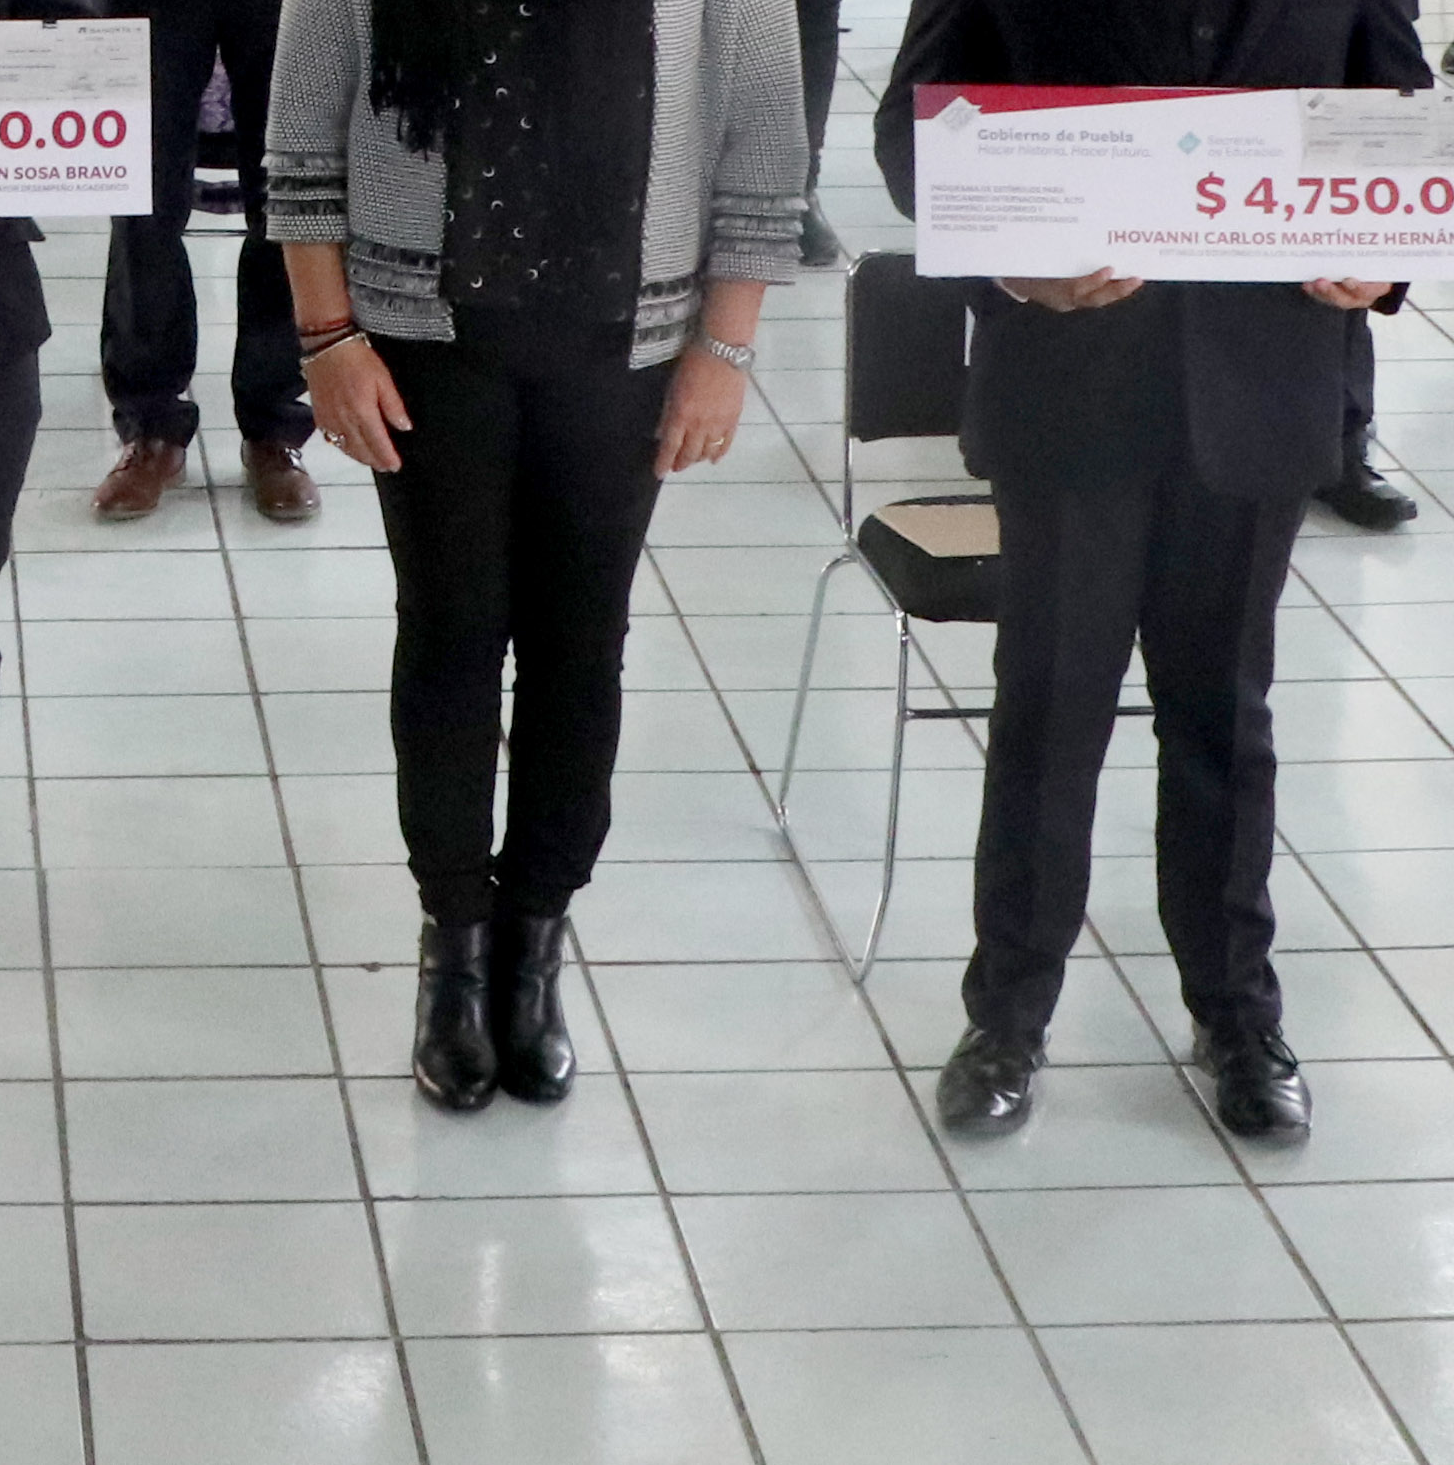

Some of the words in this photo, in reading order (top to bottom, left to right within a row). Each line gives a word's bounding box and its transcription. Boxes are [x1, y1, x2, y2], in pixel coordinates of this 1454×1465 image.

[978, 128, 1051, 142] Gobierno
[1055, 129, 1076, 142] de
[1079, 130, 1134, 143] Puebla
[14, 166, 59, 180] SOSA
[65, 165, 127, 179] BRAVO
[1196, 171, 1227, 220] $
[1107, 230, 1199, 246] JHOVANNI
[1204, 231, 1276, 245] CARLOS
[1281, 228, 1379, 245] MARTÍNEZ
